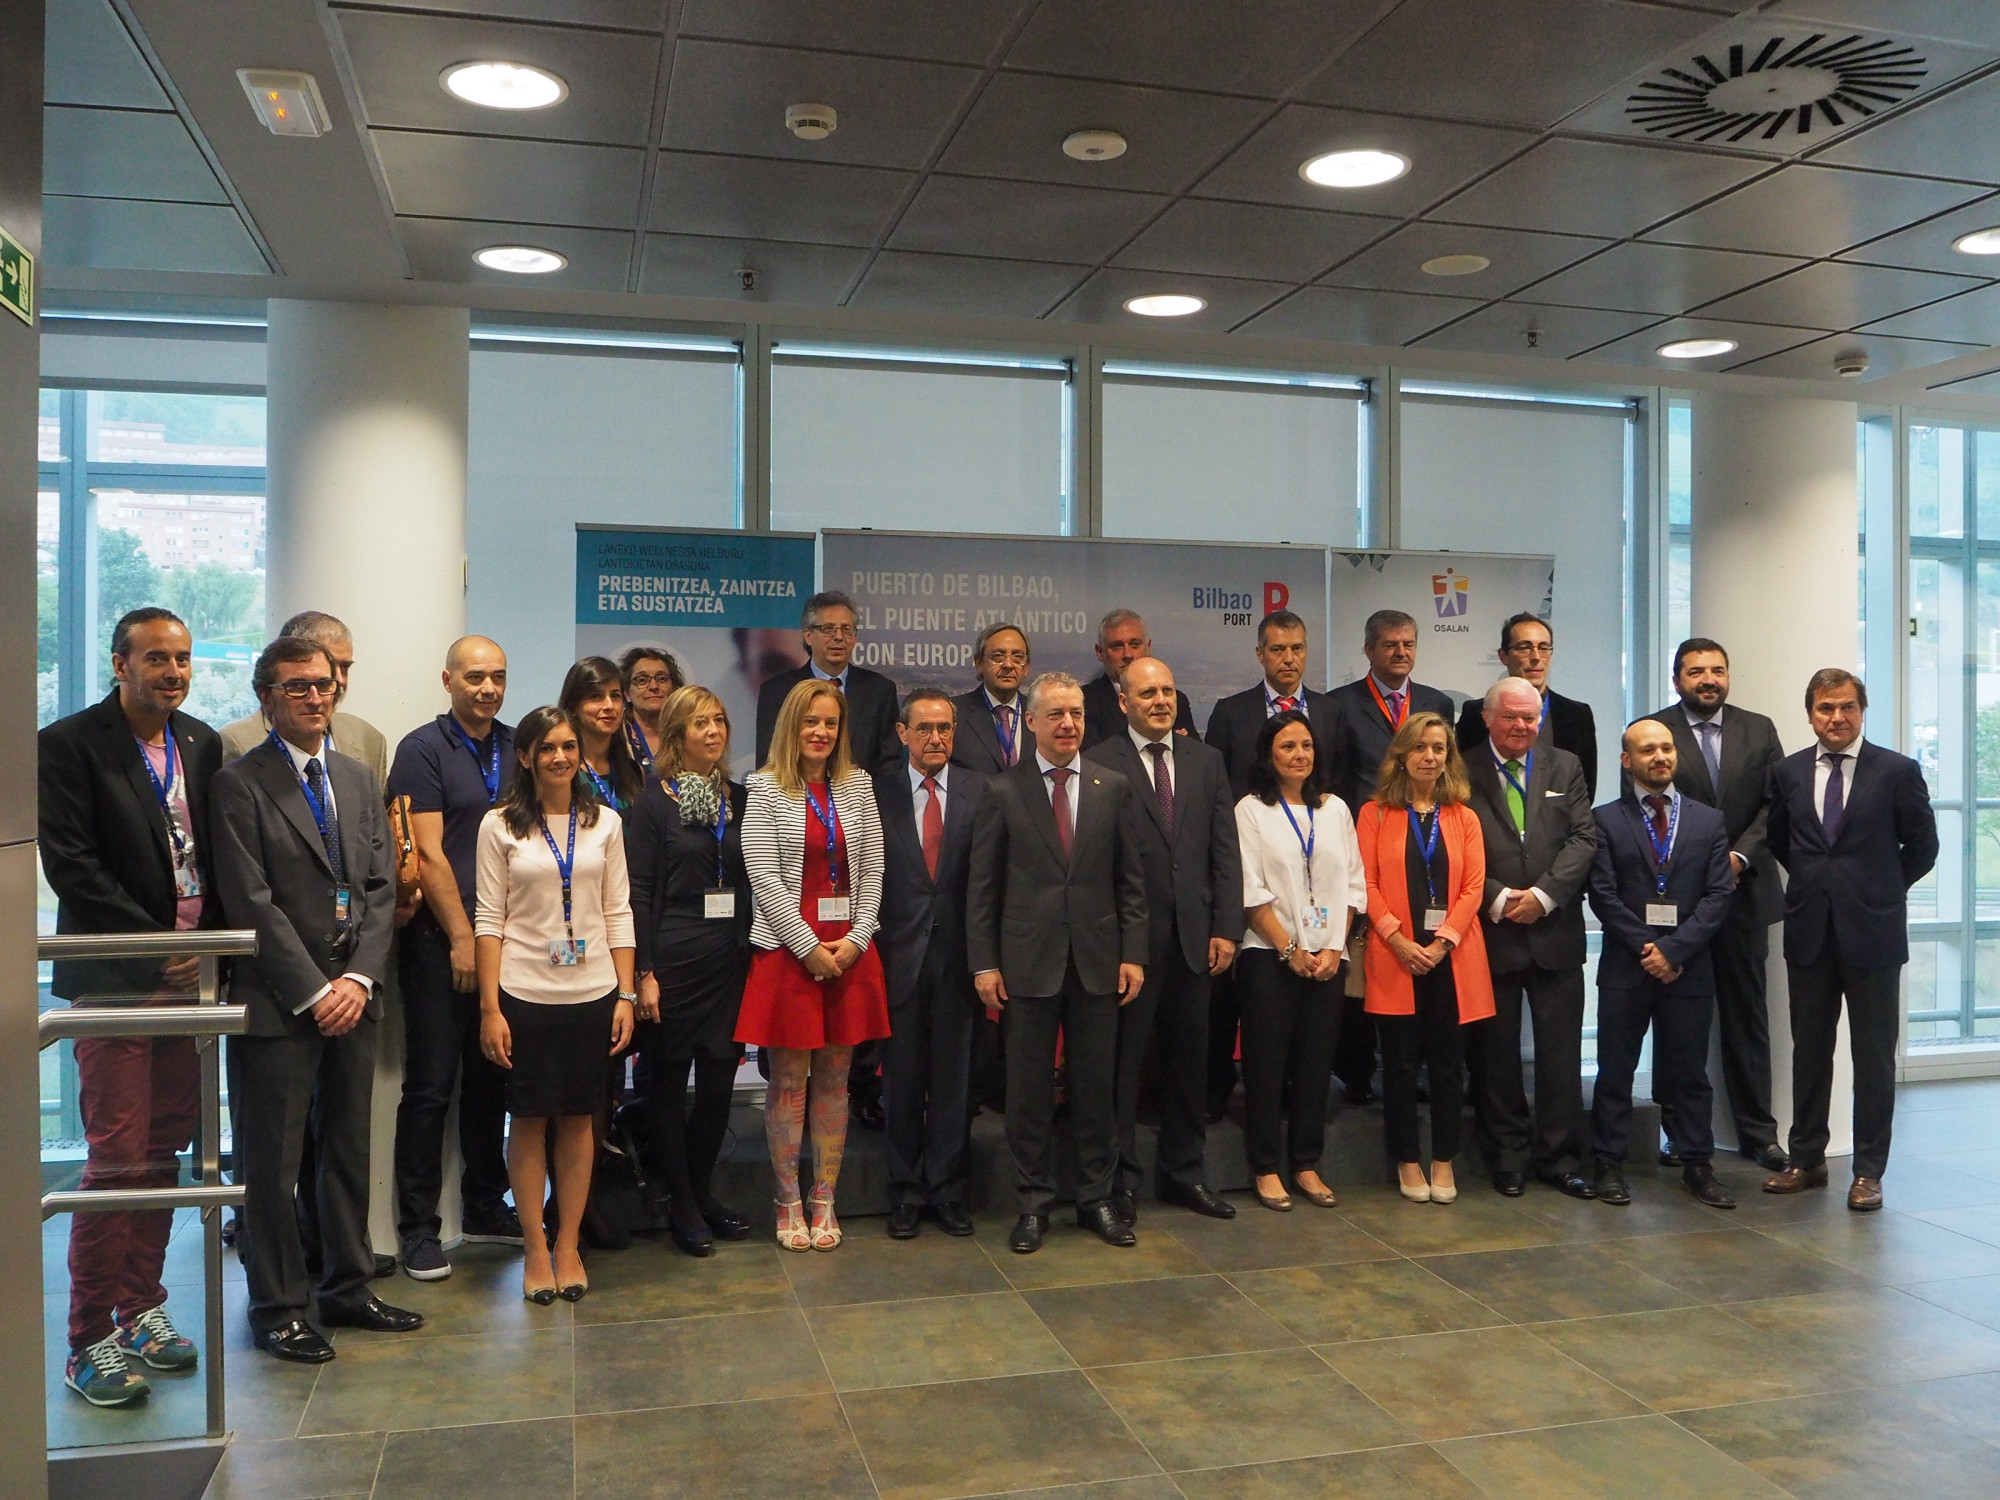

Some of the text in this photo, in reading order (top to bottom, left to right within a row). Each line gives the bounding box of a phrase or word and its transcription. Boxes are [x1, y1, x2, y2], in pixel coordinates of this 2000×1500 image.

[599, 575, 796, 597] PREBENITZEA, ZAINTZEA
[852, 571, 1059, 602] PUERTO DE BILBAO,
[599, 594, 725, 613] ETA SUSTATZEA
[1193, 587, 1252, 610] Bilbao
[885, 607, 965, 631] PUENTE
[1224, 613, 1252, 625] PORT
[1434, 624, 1469, 632] OSALAN
[852, 642, 976, 667] CON EUROP
